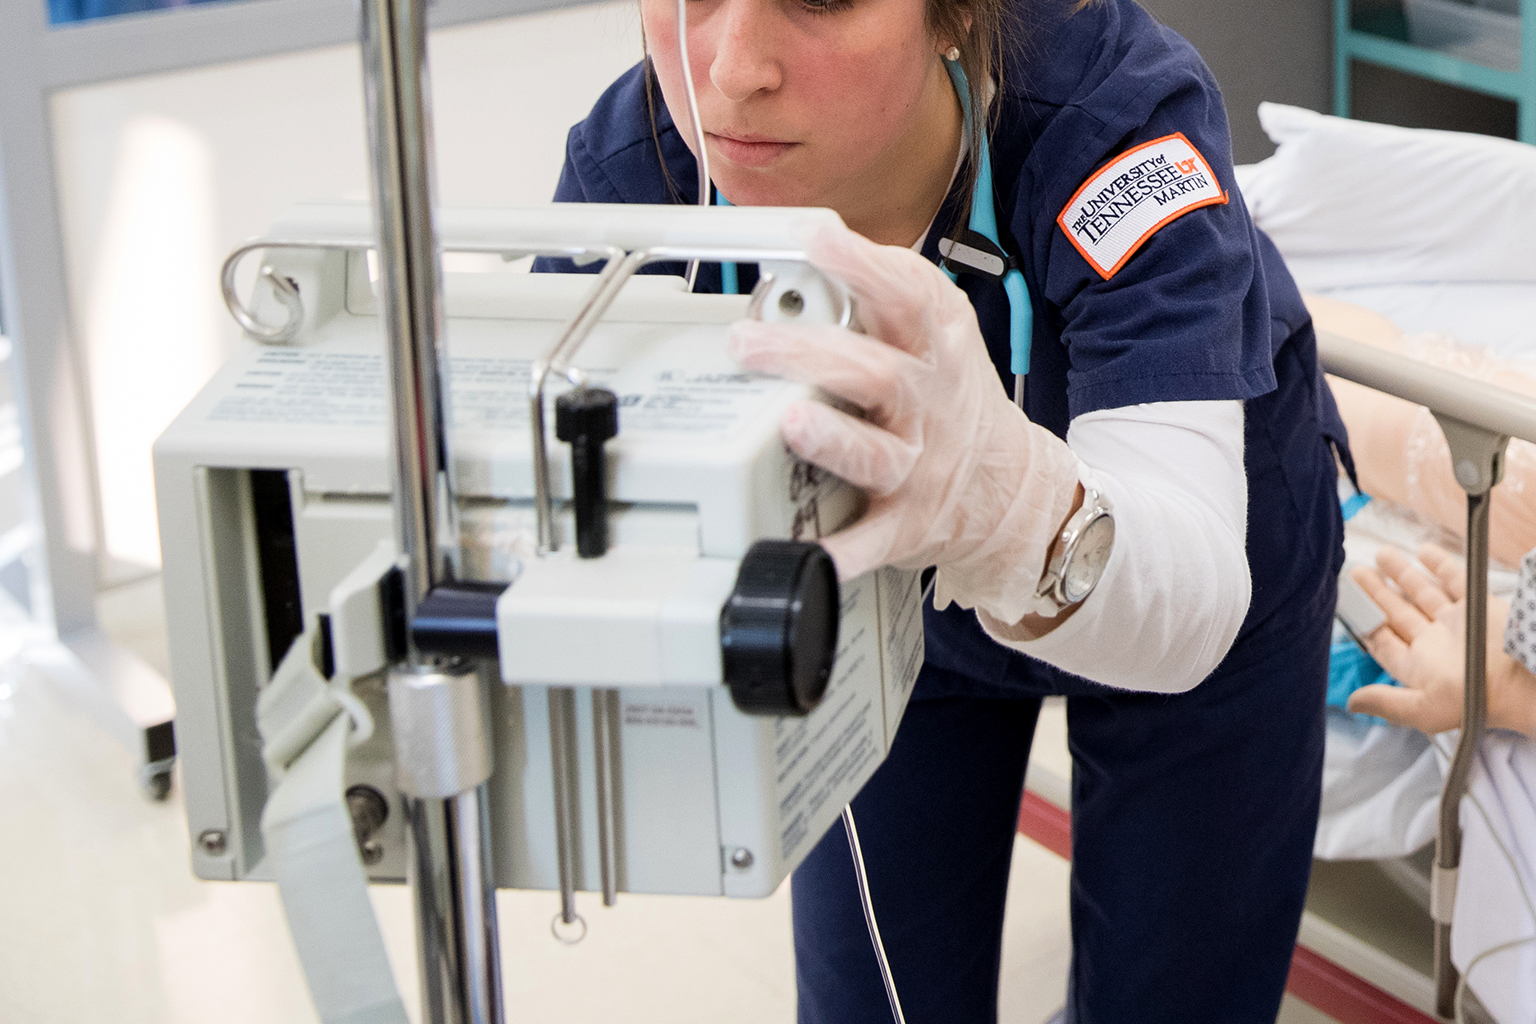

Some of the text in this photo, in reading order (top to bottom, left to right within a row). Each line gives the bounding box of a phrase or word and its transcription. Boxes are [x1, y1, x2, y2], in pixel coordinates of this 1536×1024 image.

[1072, 154, 1167, 232] THE UNIVERSITY of
[1077, 166, 1183, 244] TENNESSEE
[1154, 175, 1209, 206] MARTIN
